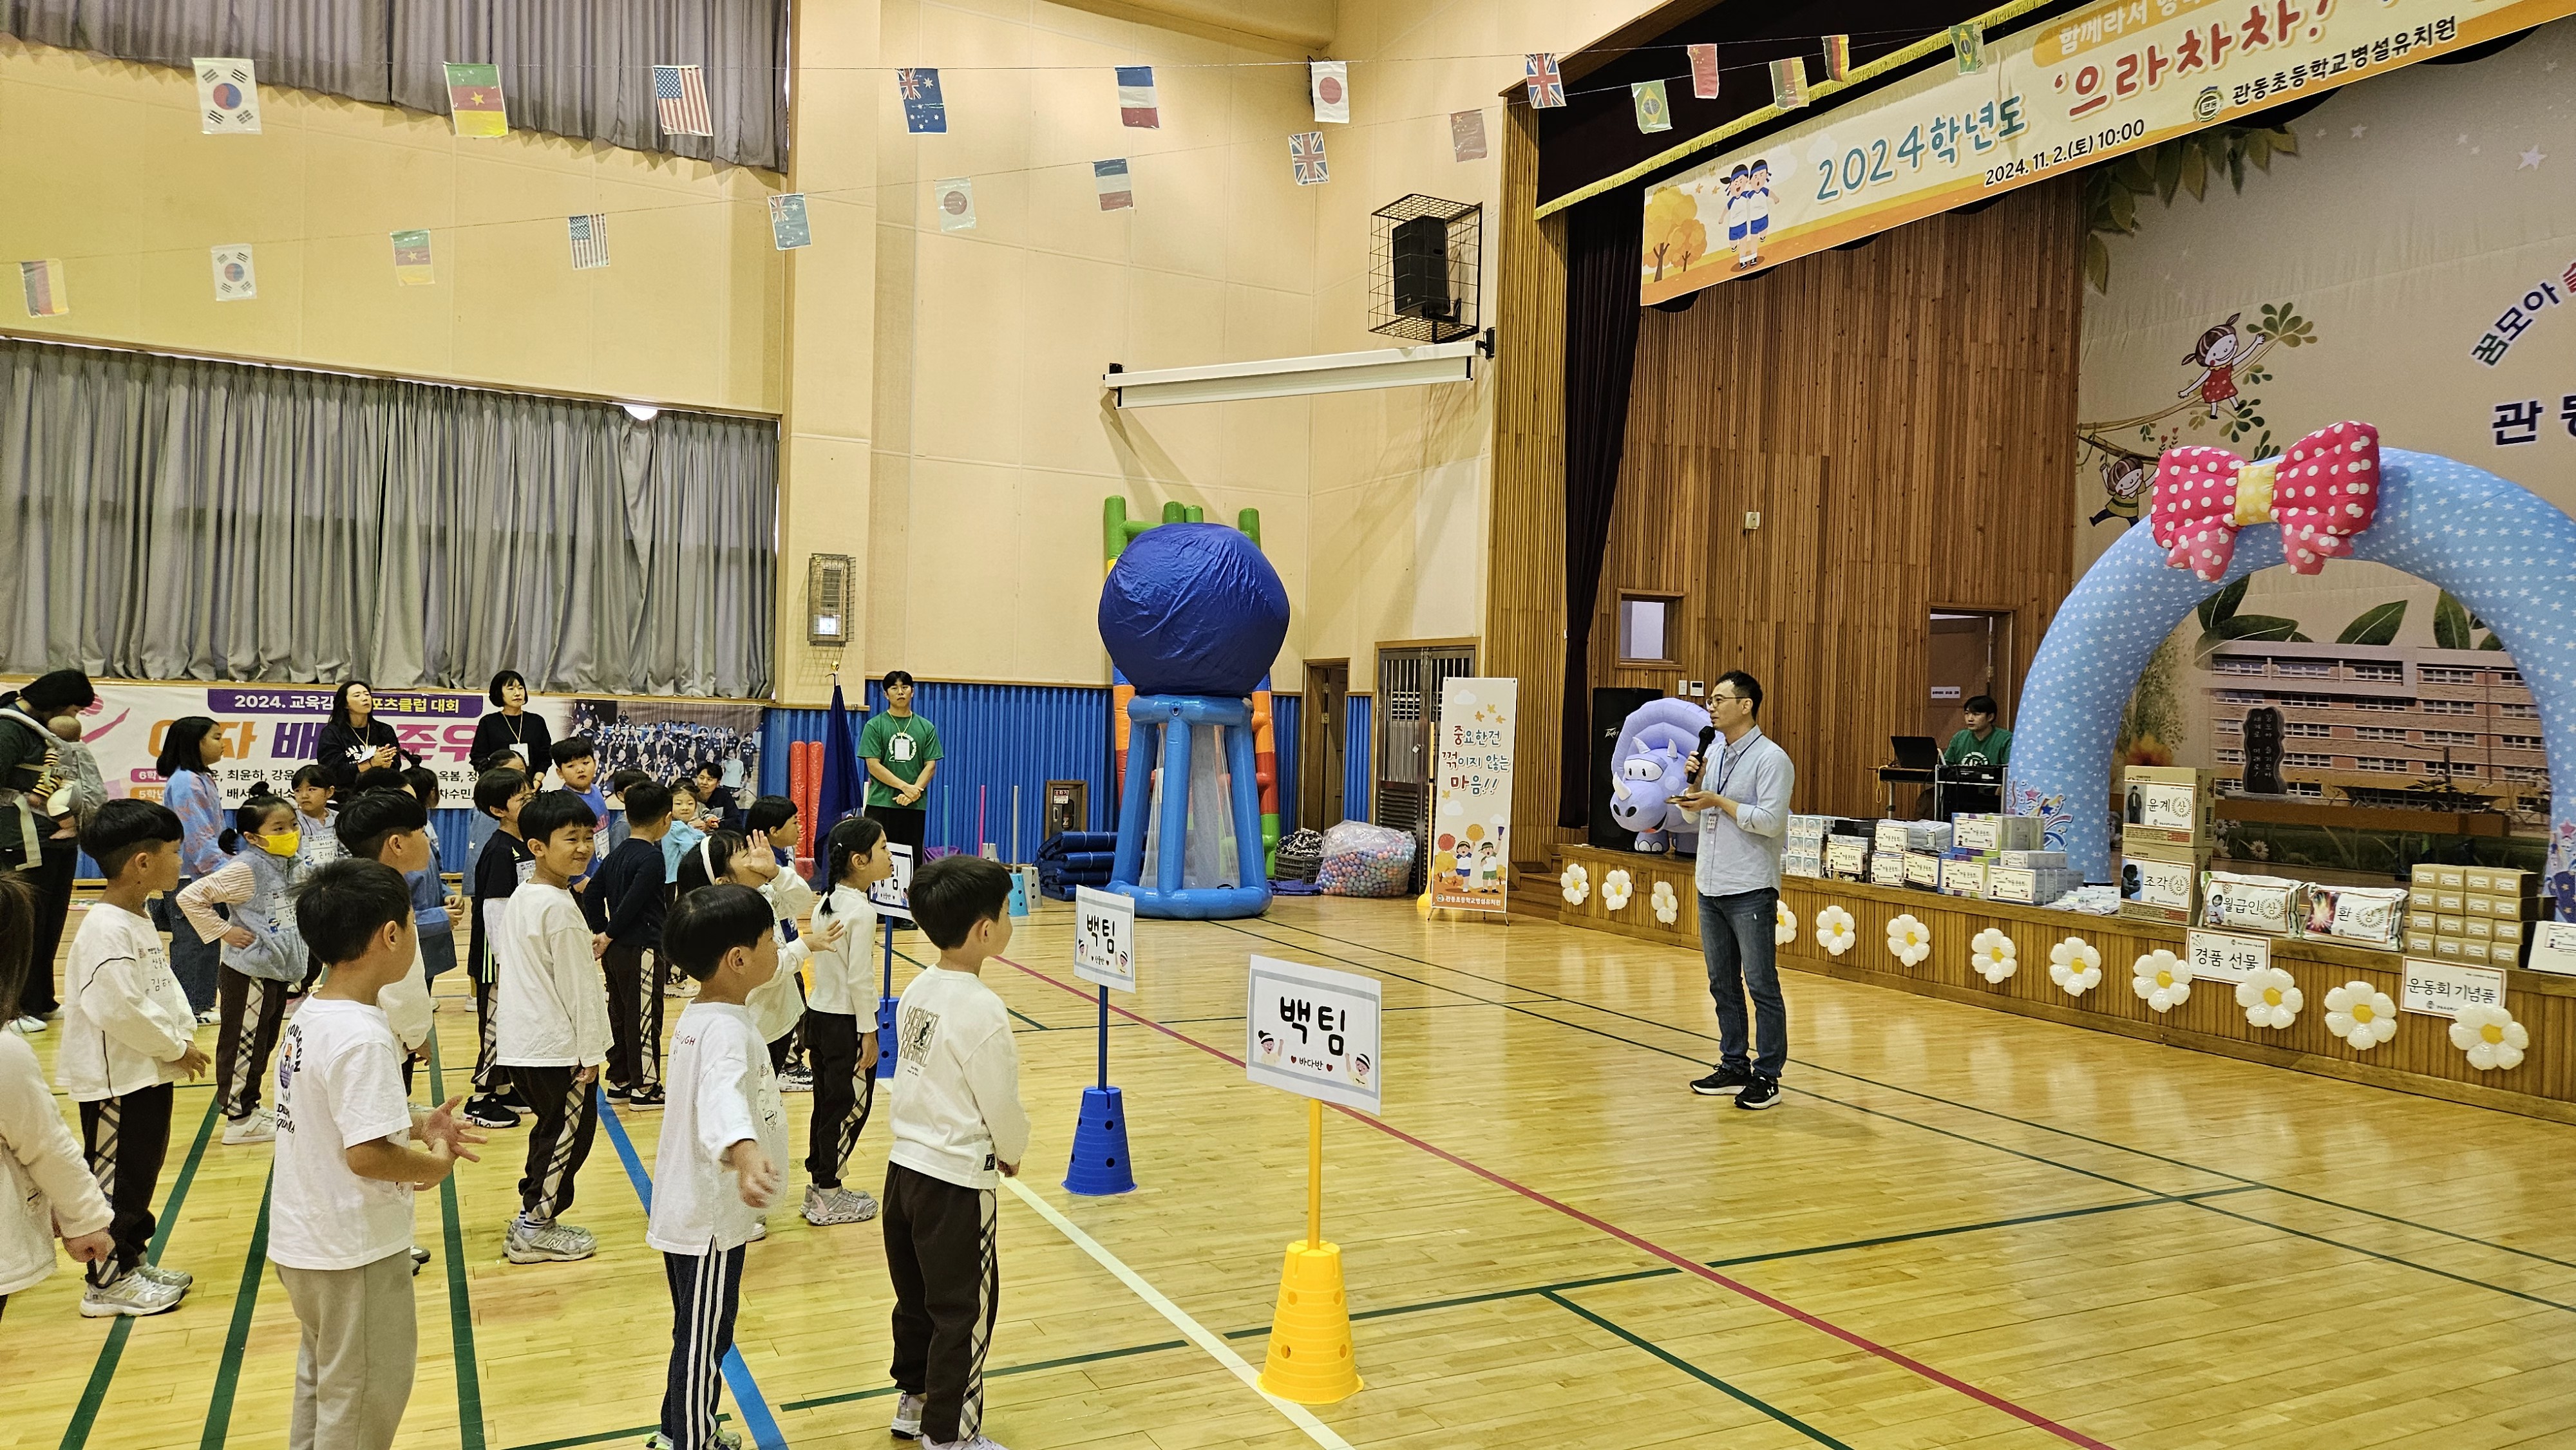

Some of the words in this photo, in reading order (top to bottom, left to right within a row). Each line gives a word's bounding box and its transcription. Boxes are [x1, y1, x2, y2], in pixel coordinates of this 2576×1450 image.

[2060, 2, 2147, 55] 함께라서
[2233, 15, 2456, 106] 관동초등학교병설유치원
[1816, 95, 2026, 200] 2024학년도
[1985, 161, 2029, 187] 2024.
[2032, 152, 2050, 171] 11.
[2098, 118, 2145, 149] 10:00
[2471, 281, 2561, 366] 꿈모아
[234, 695, 286, 708] 2024.
[290, 695, 335, 710] 교육감
[372, 697, 427, 713] 포츠클럽
[431, 699, 459, 713] 대회
[271, 722, 328, 760] 배
[395, 724, 478, 763] 준우
[1454, 725, 1501, 746] 중요한건
[227, 769, 268, 782] 최윤하,
[272, 769, 294, 781] 강윤
[1486, 753, 1510, 771] 않는
[1450, 775, 1499, 796] 마음!!
[1086, 914, 1115, 955] 백팀
[2195, 947, 2224, 967] 경품
[2228, 951, 2259, 971] 선물
[2407, 978, 2450, 997] 운동회
[2454, 984, 2497, 1004] 기념품
[1280, 995, 1346, 1057] 백팀
[1298, 1057, 1324, 1071] 바다반
